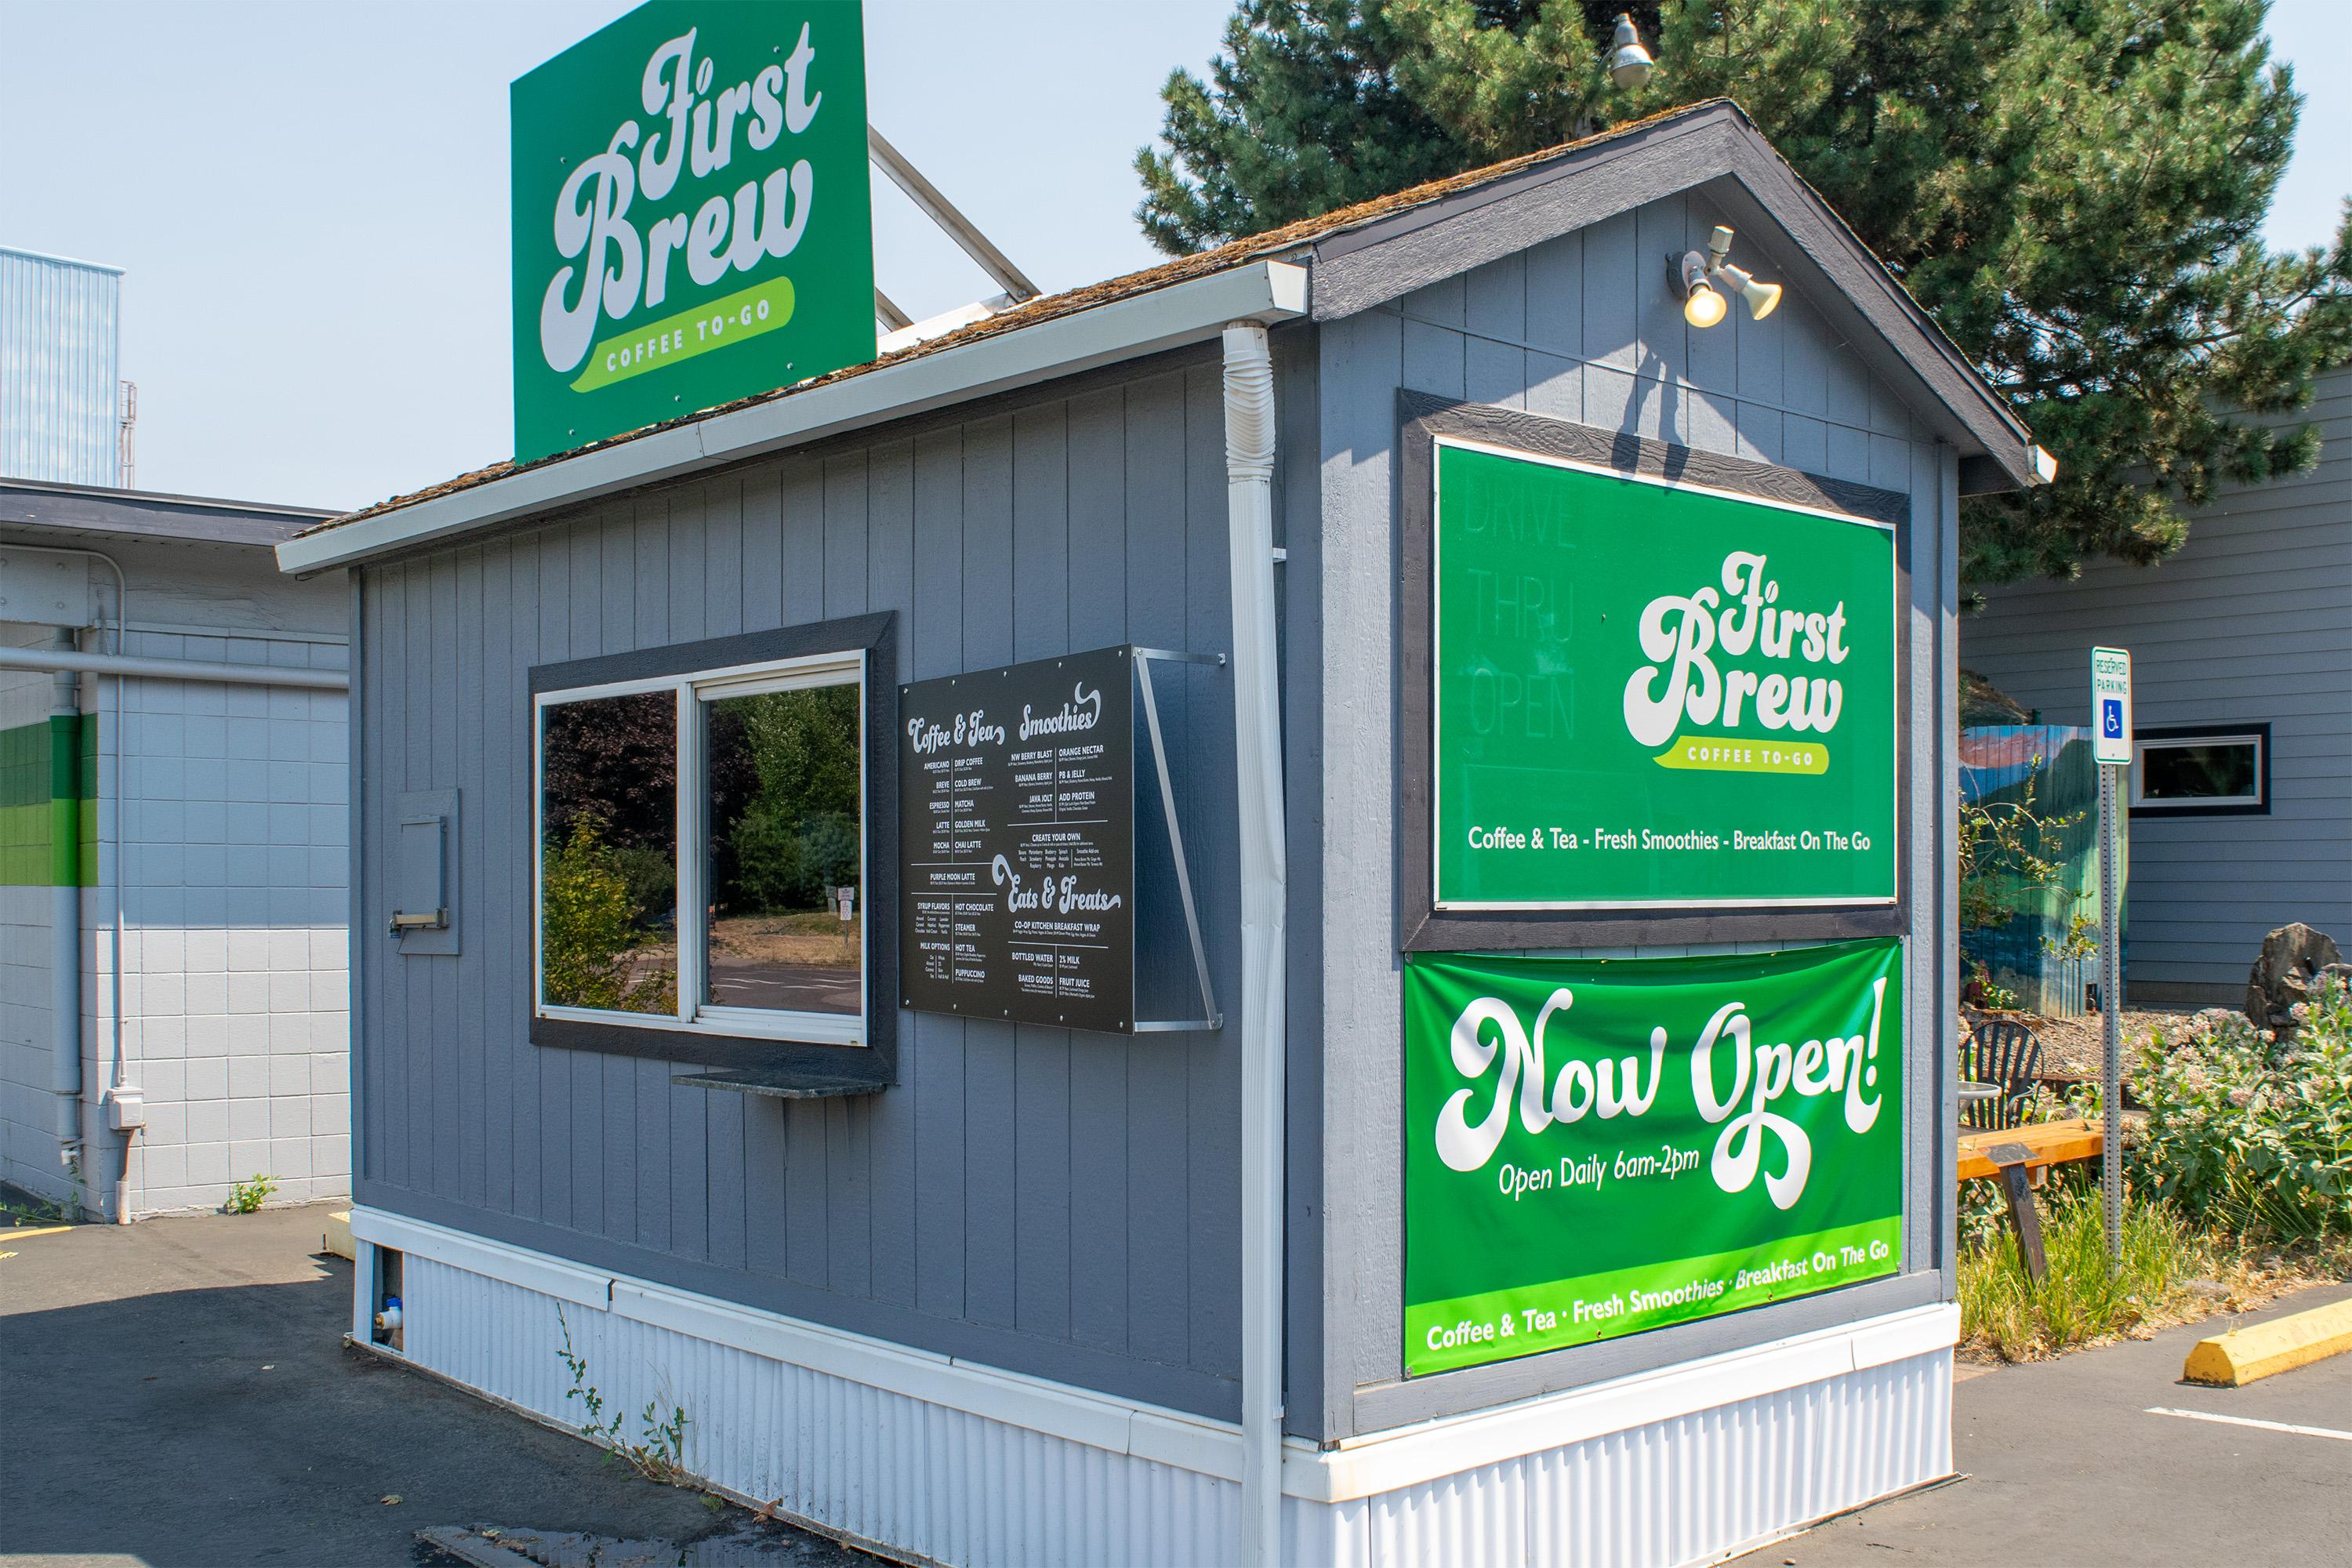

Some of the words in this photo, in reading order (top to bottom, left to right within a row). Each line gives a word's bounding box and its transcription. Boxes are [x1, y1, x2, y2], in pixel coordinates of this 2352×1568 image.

[639, 21, 822, 201] First
[540, 121, 813, 372] Brew
[607, 329, 683, 372] COFFEE
[697, 299, 770, 341] TO-GO
[1468, 568, 1573, 642] THRU
[1719, 550, 1849, 664] First
[1624, 586, 1842, 746] Brew
[2096, 659, 2127, 675] RESERVED
[2096, 679, 2127, 694] PARKING
[1472, 668, 1574, 739] OPEN
[1019, 681, 1101, 741] Smoothies
[908, 717, 950, 754] Coffee
[953, 713, 966, 745] &
[967, 710, 1004, 746] Tea
[1021, 751, 1036, 760] BERRY
[1036, 750, 1053, 759] BLAST
[1058, 746, 1081, 757] ORANGE
[1082, 745, 1104, 754] NECTAR
[1688, 746, 1751, 763] COFFEE
[1762, 750, 1813, 765] TO-GO
[924, 760, 949, 770] AMERICANO
[966, 757, 983, 766] COFFEE
[1014, 773, 1036, 782] BANANA
[1036, 772, 1053, 781] BERRY
[1072, 769, 1086, 778] JELLY
[954, 779, 967, 788] COLD
[1029, 795, 1041, 804] JAVA
[1058, 793, 1071, 801] ADD
[1072, 791, 1095, 800] PROTEIN
[1032, 833, 1051, 842] CREATE
[1051, 833, 1066, 841] YOUR
[1468, 826, 1526, 849] Coffee
[1531, 828, 1544, 849] &
[1550, 828, 1577, 849] Tea
[1595, 829, 1637, 850] Fresh
[1642, 829, 1719, 850] Smoothies
[1733, 830, 1796, 851] Breakfast
[1800, 831, 1820, 850] On
[1824, 832, 1849, 850] The
[1852, 833, 1871, 851] Go
[992, 854, 1038, 913] Eats
[1041, 876, 1055, 909] &
[1059, 875, 1121, 914] Treats
[1031, 921, 1053, 930] KITCHEN
[1054, 922, 1083, 931] BREAKFAST
[1083, 924, 1101, 932] WRAP
[931, 942, 950, 951] OPTIONS
[1011, 952, 1034, 961] BOTTLED
[1035, 953, 1054, 963] WATER
[1067, 956, 1080, 964] MILK
[955, 969, 985, 978] PUPPUCCINO
[1035, 975, 1054, 985] GOODS
[1059, 977, 1075, 986] FRUIT
[1075, 978, 1090, 988] JUICE
[1436, 988, 1668, 1171] Now
[1691, 977, 1888, 1210] Open!
[1499, 1163, 1553, 1201] Open
[1561, 1154, 1605, 1190] Daily
[1614, 1145, 1700, 1180] 6am-2pm
[1427, 1320, 1494, 1351] Coffee
[1500, 1314, 1515, 1337] &
[1523, 1309, 1556, 1333] Tea
[1573, 1294, 1624, 1323] Fresh
[1630, 1279, 1724, 1314] Smoothies
[1735, 1257, 1809, 1291] Breakfast
[1813, 1251, 1836, 1272] On
[1840, 1247, 1865, 1267] The
[1869, 1240, 1889, 1260] Go
